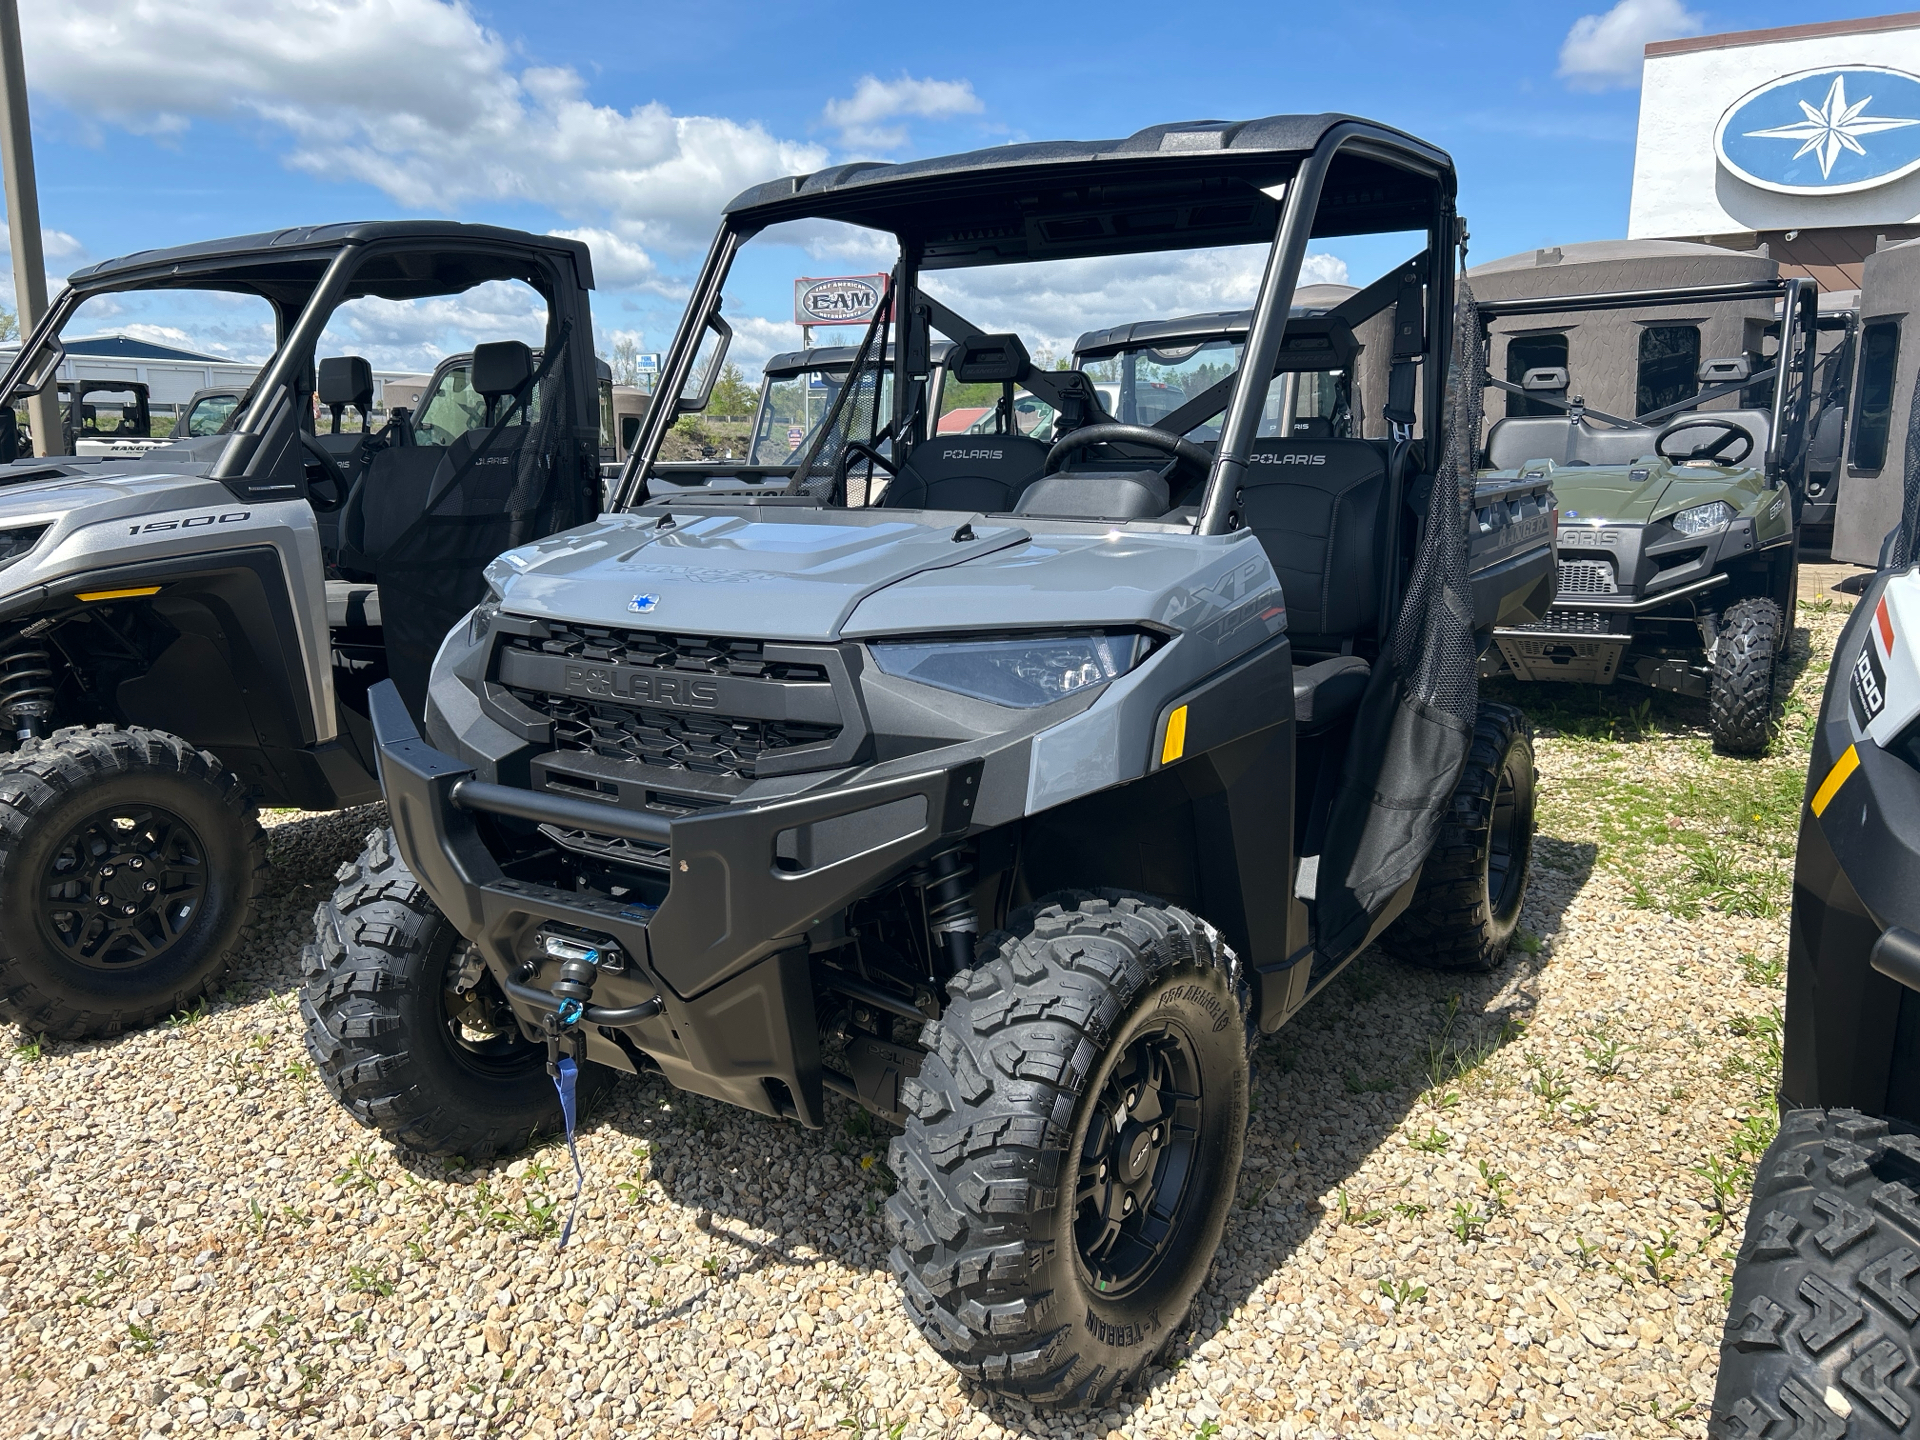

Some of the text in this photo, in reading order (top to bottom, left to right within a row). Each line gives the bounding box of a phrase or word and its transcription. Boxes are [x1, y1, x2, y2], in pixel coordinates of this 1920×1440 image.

[815, 282, 866, 292] EAST AMERICAN
[943, 449, 1003, 460] POLARIS
[1249, 453, 1326, 465] POLARIS
[129, 512, 251, 535] 1500
[1172, 554, 1271, 628] XP
[1217, 589, 1272, 635] 1000
[565, 664, 720, 709] POLARIS
[1857, 649, 1883, 712] 1000
[1157, 985, 1221, 1020] PRO ARMOR
[1085, 1304, 1161, 1348] X-TERRAIN
